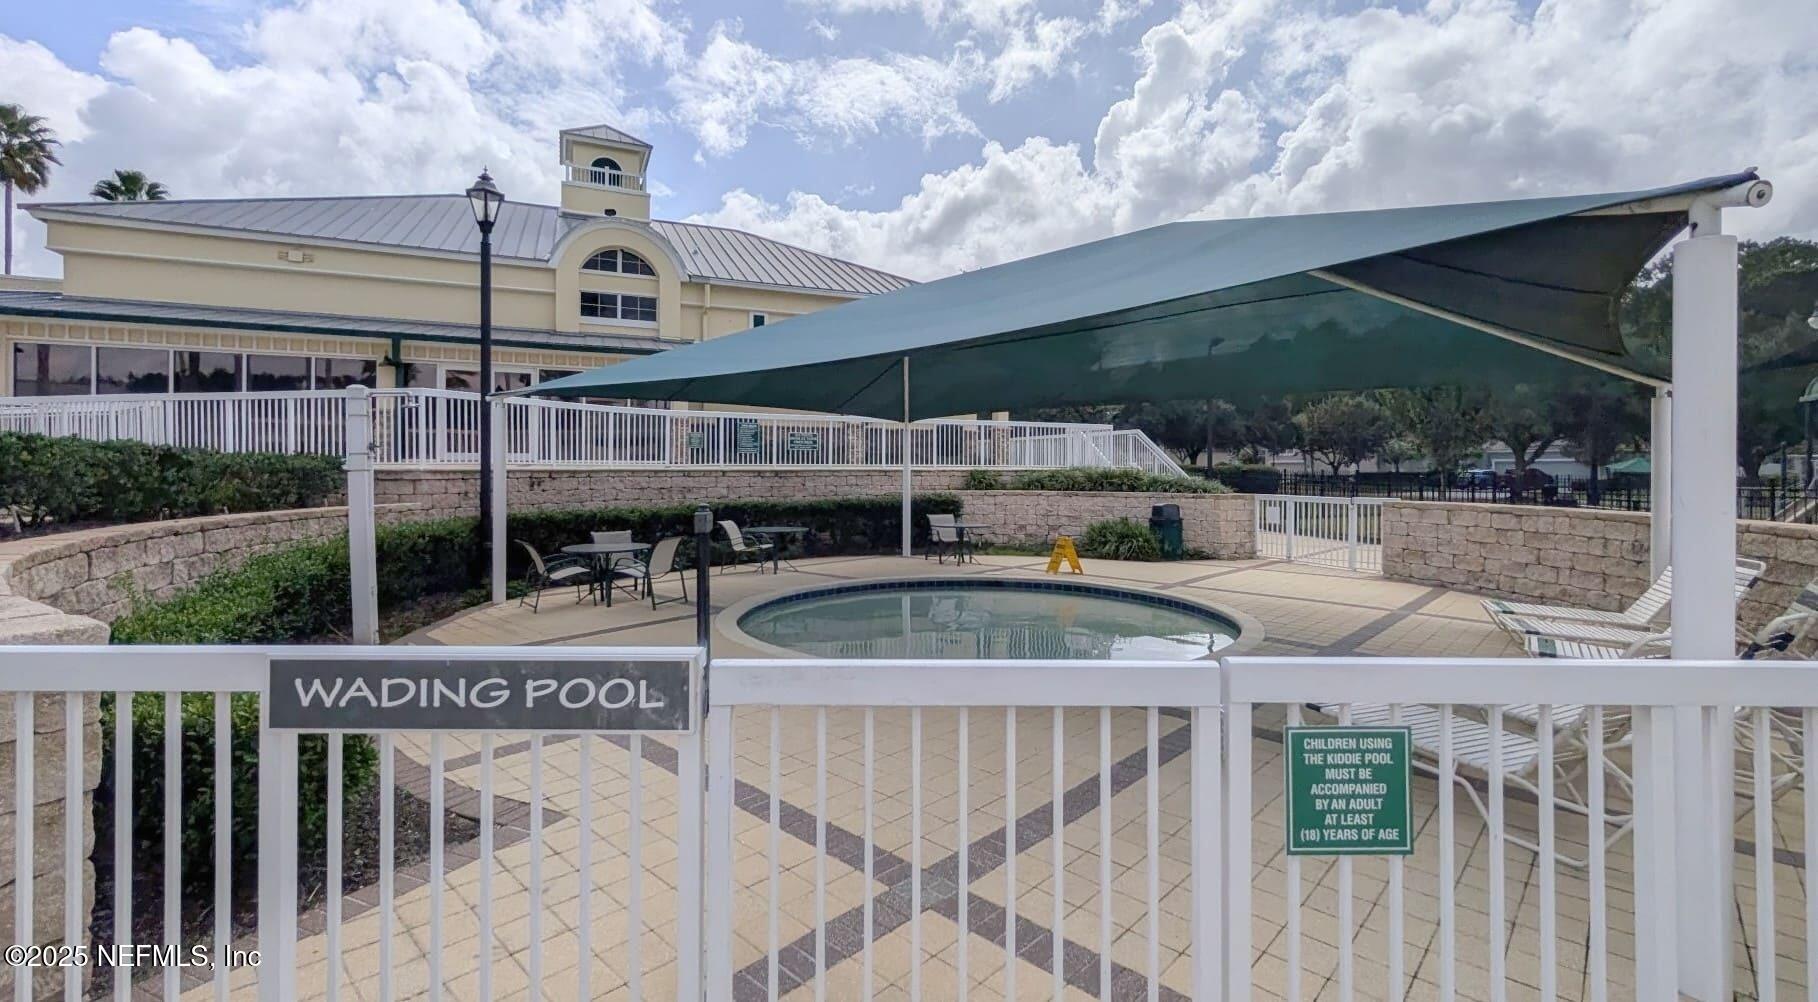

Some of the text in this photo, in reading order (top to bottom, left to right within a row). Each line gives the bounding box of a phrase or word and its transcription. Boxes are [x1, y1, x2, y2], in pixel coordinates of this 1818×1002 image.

[294, 677, 665, 709] WADING POOL
[1304, 738, 1392, 749] CHILDREN USING
[1303, 753, 1394, 764] THE KIDDIE POOL
[1325, 768, 1373, 780] MUST BE
[1310, 783, 1387, 794] ACCOMPANIED
[1315, 798, 1384, 810] BY AN ADULT
[1324, 814, 1374, 825] AT LEAST
[1300, 828, 1399, 841] (18) YEARS OF AGE
